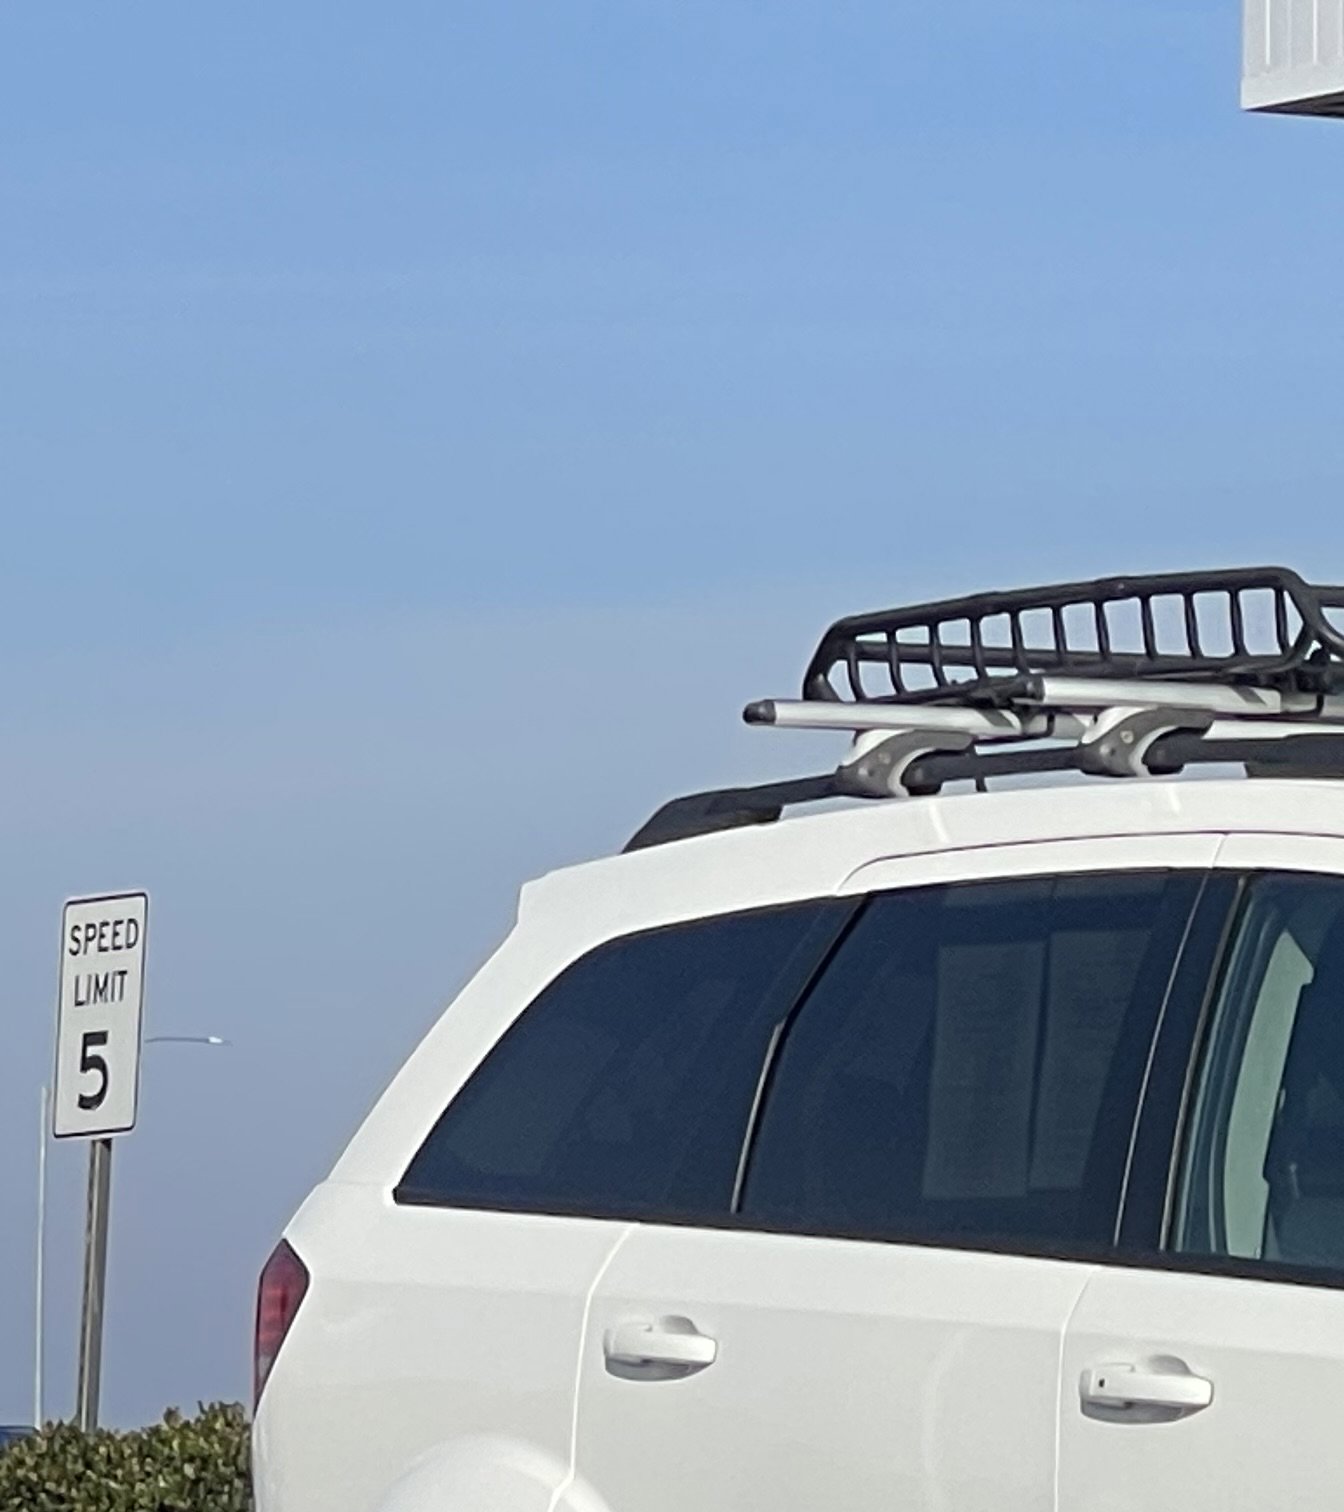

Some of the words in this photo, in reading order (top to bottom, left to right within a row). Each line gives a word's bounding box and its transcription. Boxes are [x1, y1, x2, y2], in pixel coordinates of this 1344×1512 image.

[68, 917, 139, 956] SPEED
[74, 969, 128, 1007] LIMIT
[77, 1030, 109, 1110] 5
